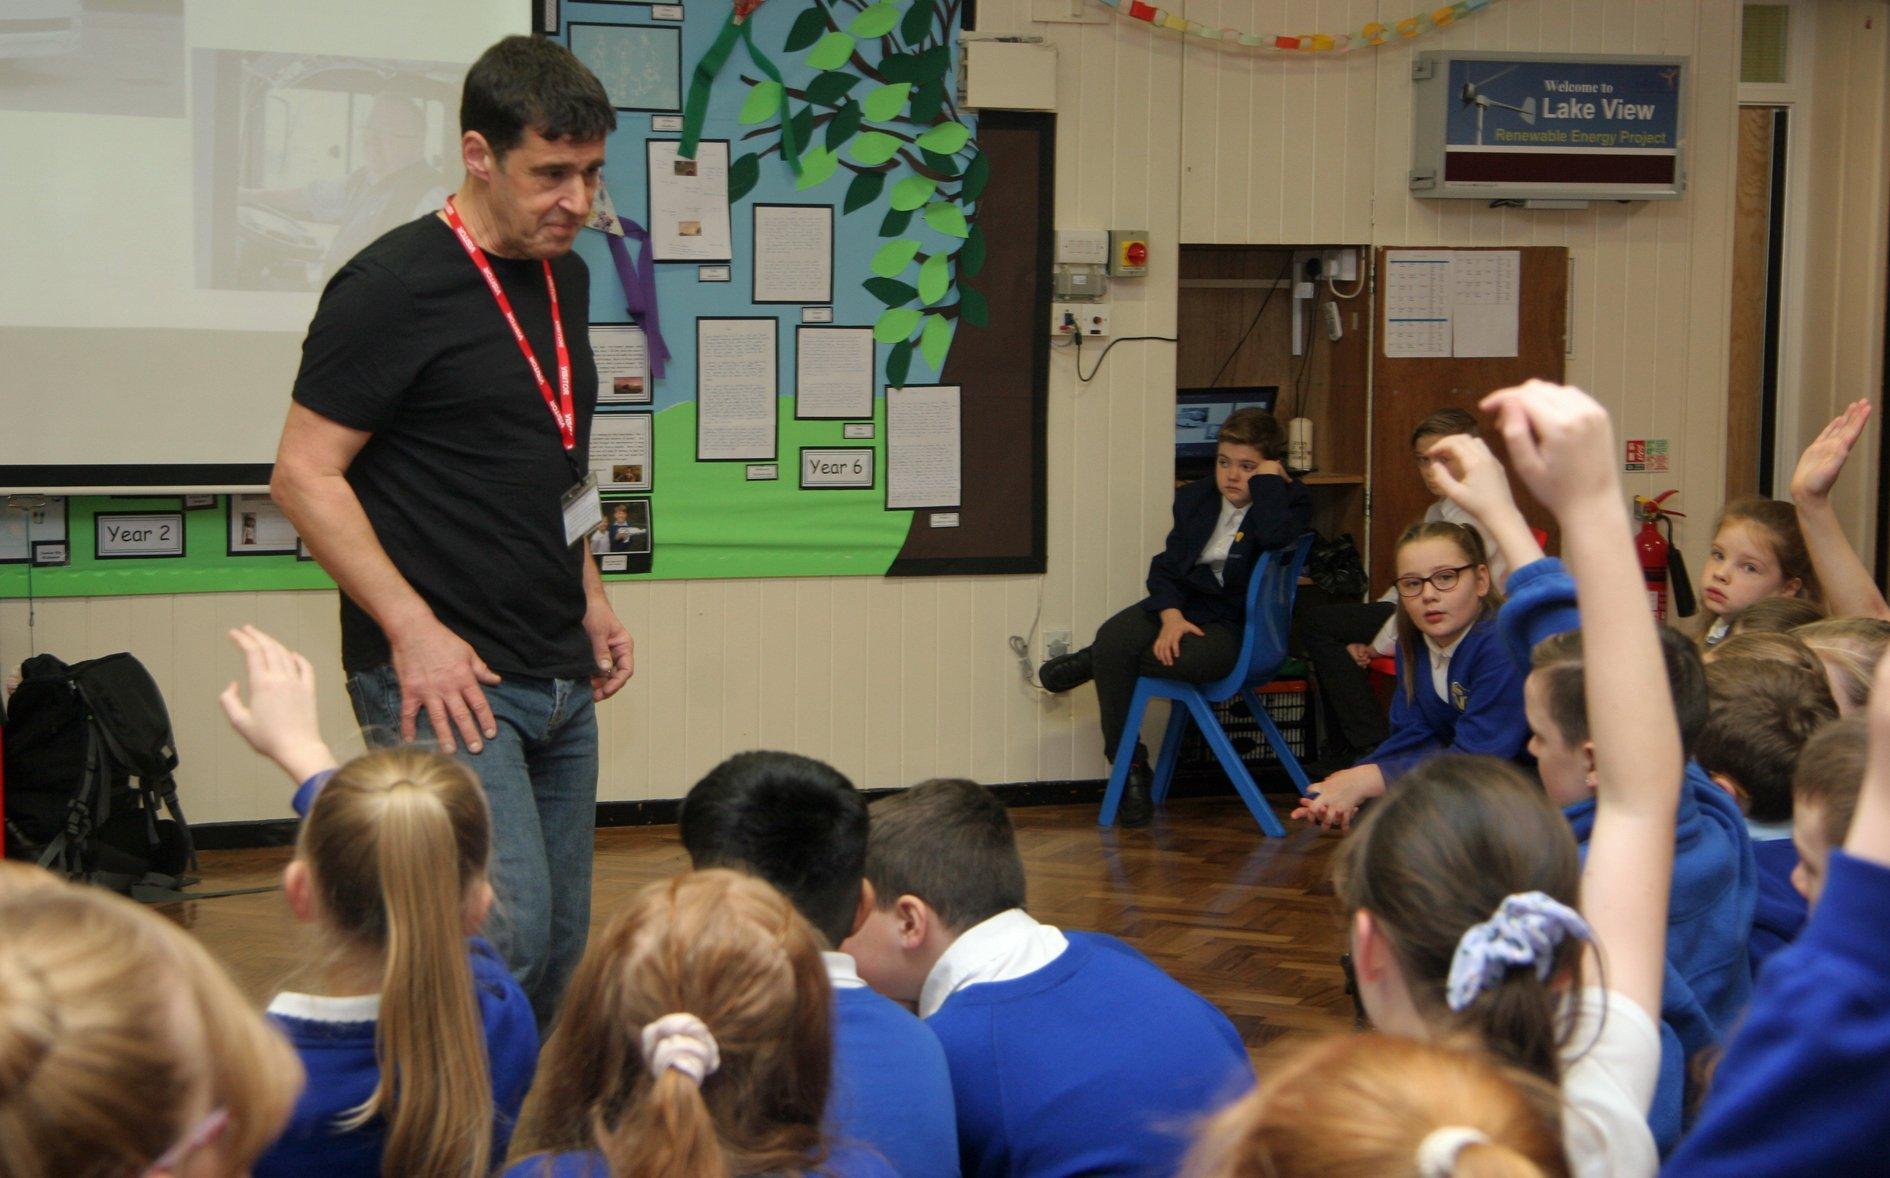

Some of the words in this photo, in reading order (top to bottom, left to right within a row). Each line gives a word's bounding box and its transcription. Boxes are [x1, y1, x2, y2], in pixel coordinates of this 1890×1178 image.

[1545, 80, 1599, 93] Welcome
[1601, 81, 1613, 93] to
[1543, 98, 1595, 119] Lake
[1601, 98, 1655, 120] View
[1496, 128, 1567, 143] Renewable
[1572, 130, 1617, 147] Energy
[1621, 131, 1667, 146] Project
[560, 366, 570, 396] VISITOR
[809, 459, 847, 475] Year
[852, 458, 863, 475] 6
[107, 526, 152, 544] Year
[159, 525, 170, 542] 2
